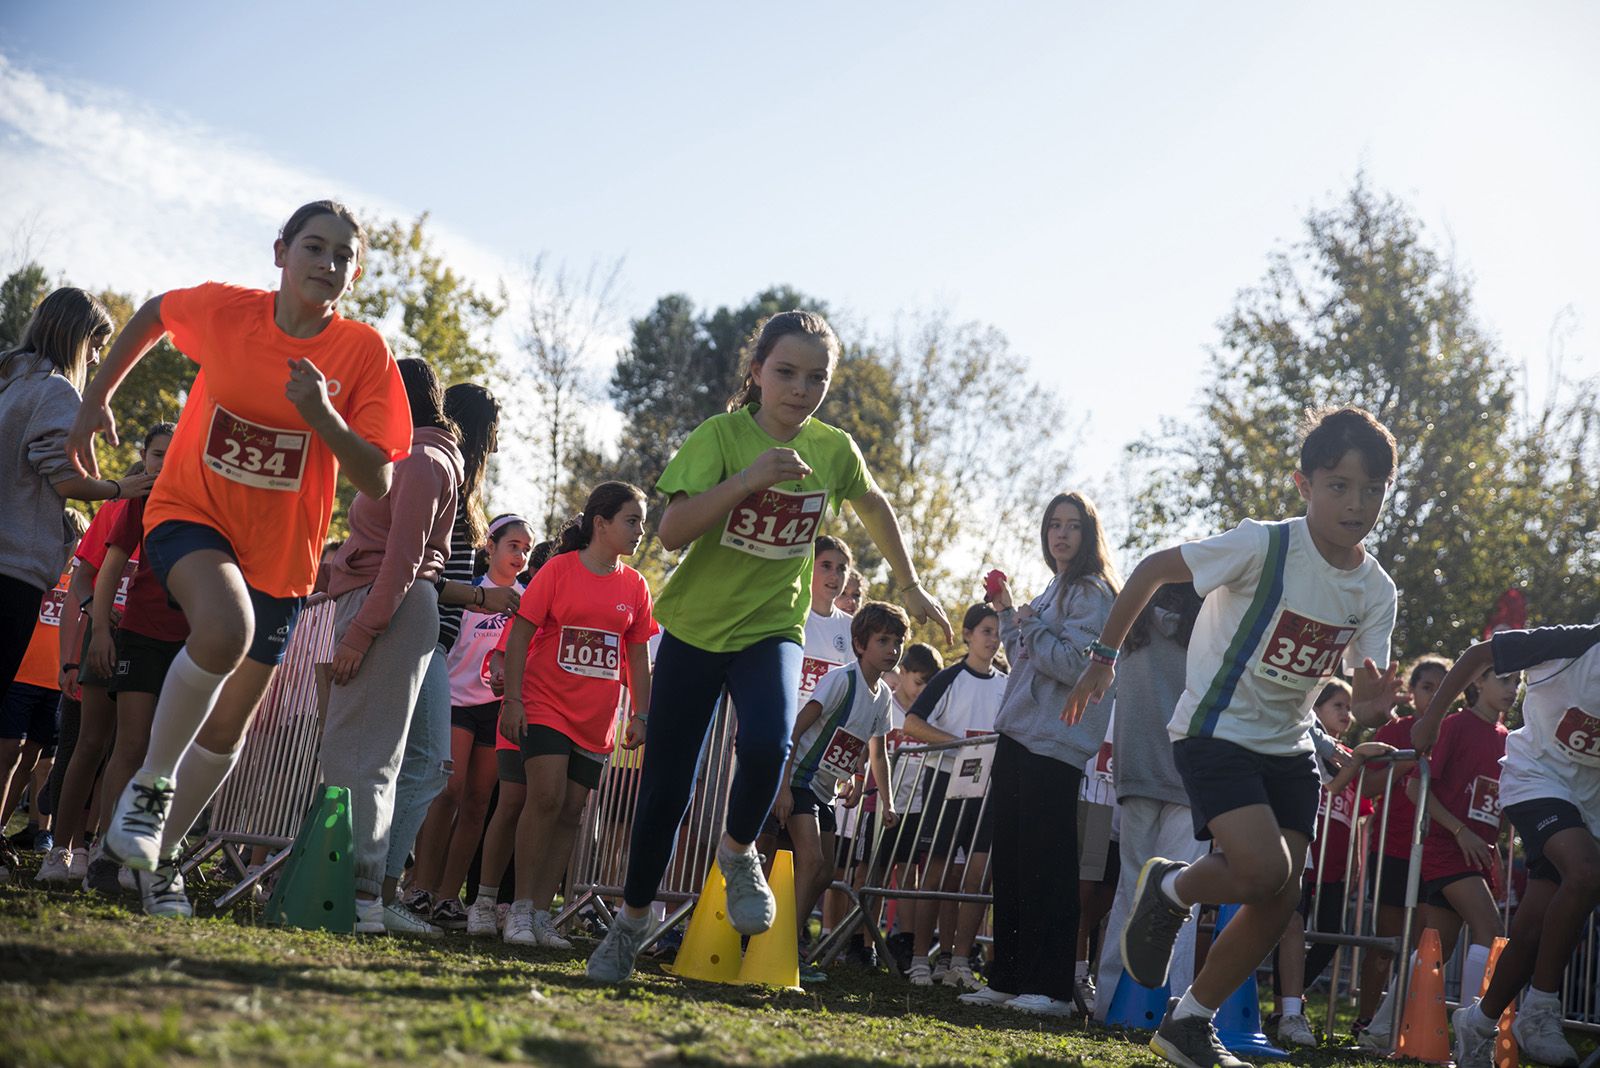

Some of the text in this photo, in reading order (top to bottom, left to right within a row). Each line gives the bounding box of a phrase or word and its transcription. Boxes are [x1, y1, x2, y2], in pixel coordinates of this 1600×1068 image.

[221, 438, 286, 476] 234
[734, 508, 814, 543] 3142
[564, 644, 617, 668] 1016
[1269, 637, 1339, 676] 3541
